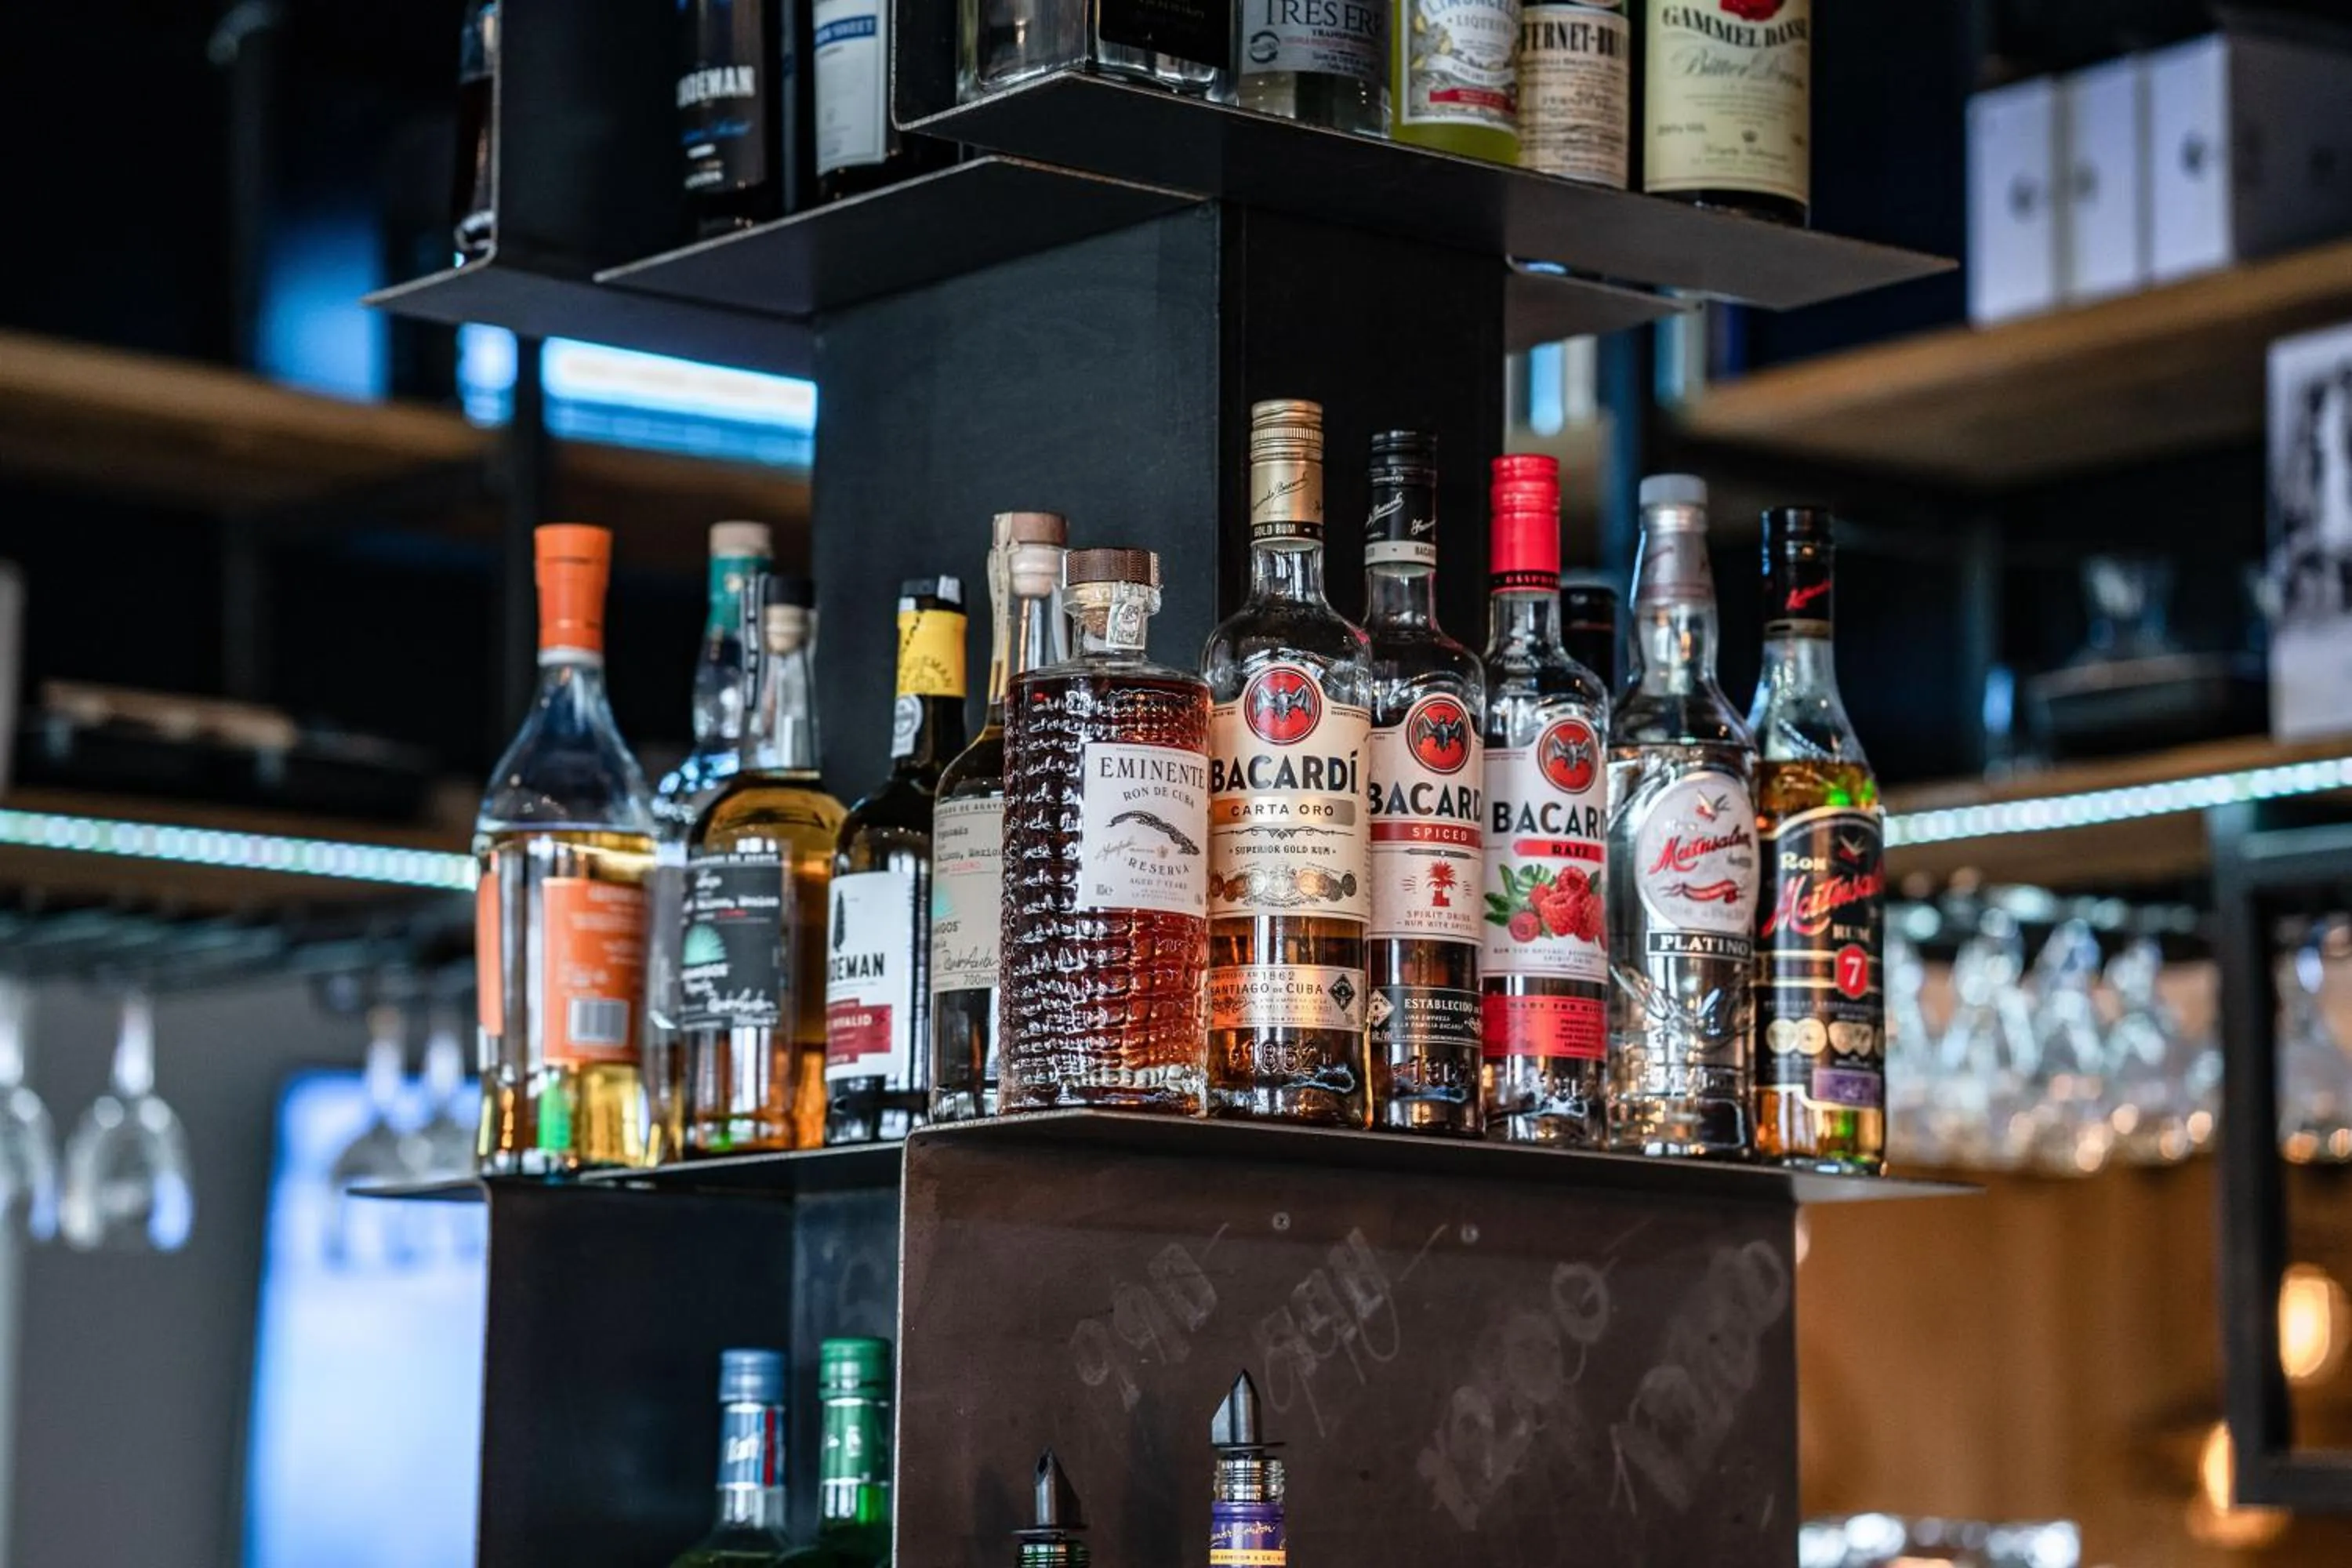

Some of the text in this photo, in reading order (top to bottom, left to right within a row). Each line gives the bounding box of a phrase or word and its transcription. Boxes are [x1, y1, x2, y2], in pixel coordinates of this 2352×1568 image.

[1661, 6, 1761, 48] GAMMEL
[1099, 757, 1205, 789] EMINENTE
[1211, 750, 1358, 793] BACARDÍ
[1123, 786, 1195, 809] RON DE CUBA
[1230, 804, 1334, 817] CARTA ORO
[1412, 827, 1468, 842] SPICED
[1235, 845, 1331, 855] SUPERIOR GOLD RUM
[1128, 856, 1191, 877] RESERVA
[1659, 934, 1748, 956] PLATINO
[1263, 971, 1295, 980] 1862
[1845, 956, 1863, 987] 7
[1210, 982, 1269, 995] SANTIAGO
[1285, 982, 1323, 995] CUBA
[1404, 997, 1473, 1014] ESTABLECIDO
